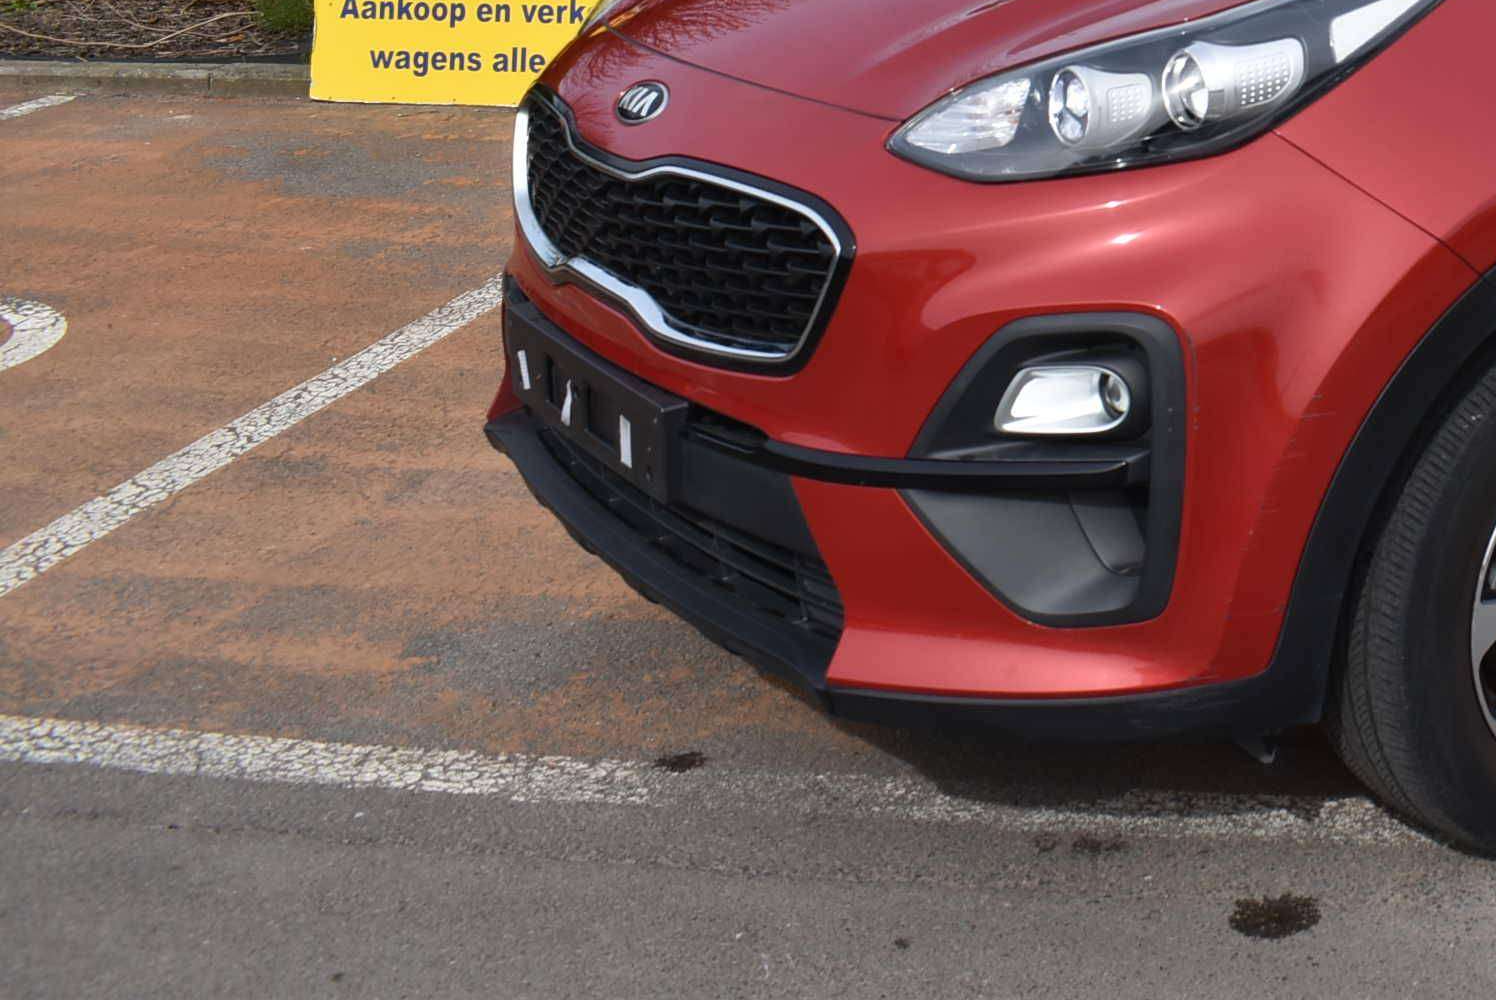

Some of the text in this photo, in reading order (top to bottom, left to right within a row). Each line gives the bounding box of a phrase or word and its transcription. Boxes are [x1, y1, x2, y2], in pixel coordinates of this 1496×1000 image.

[476, 3, 511, 23] en
[369, 46, 546, 78] wagens alle
